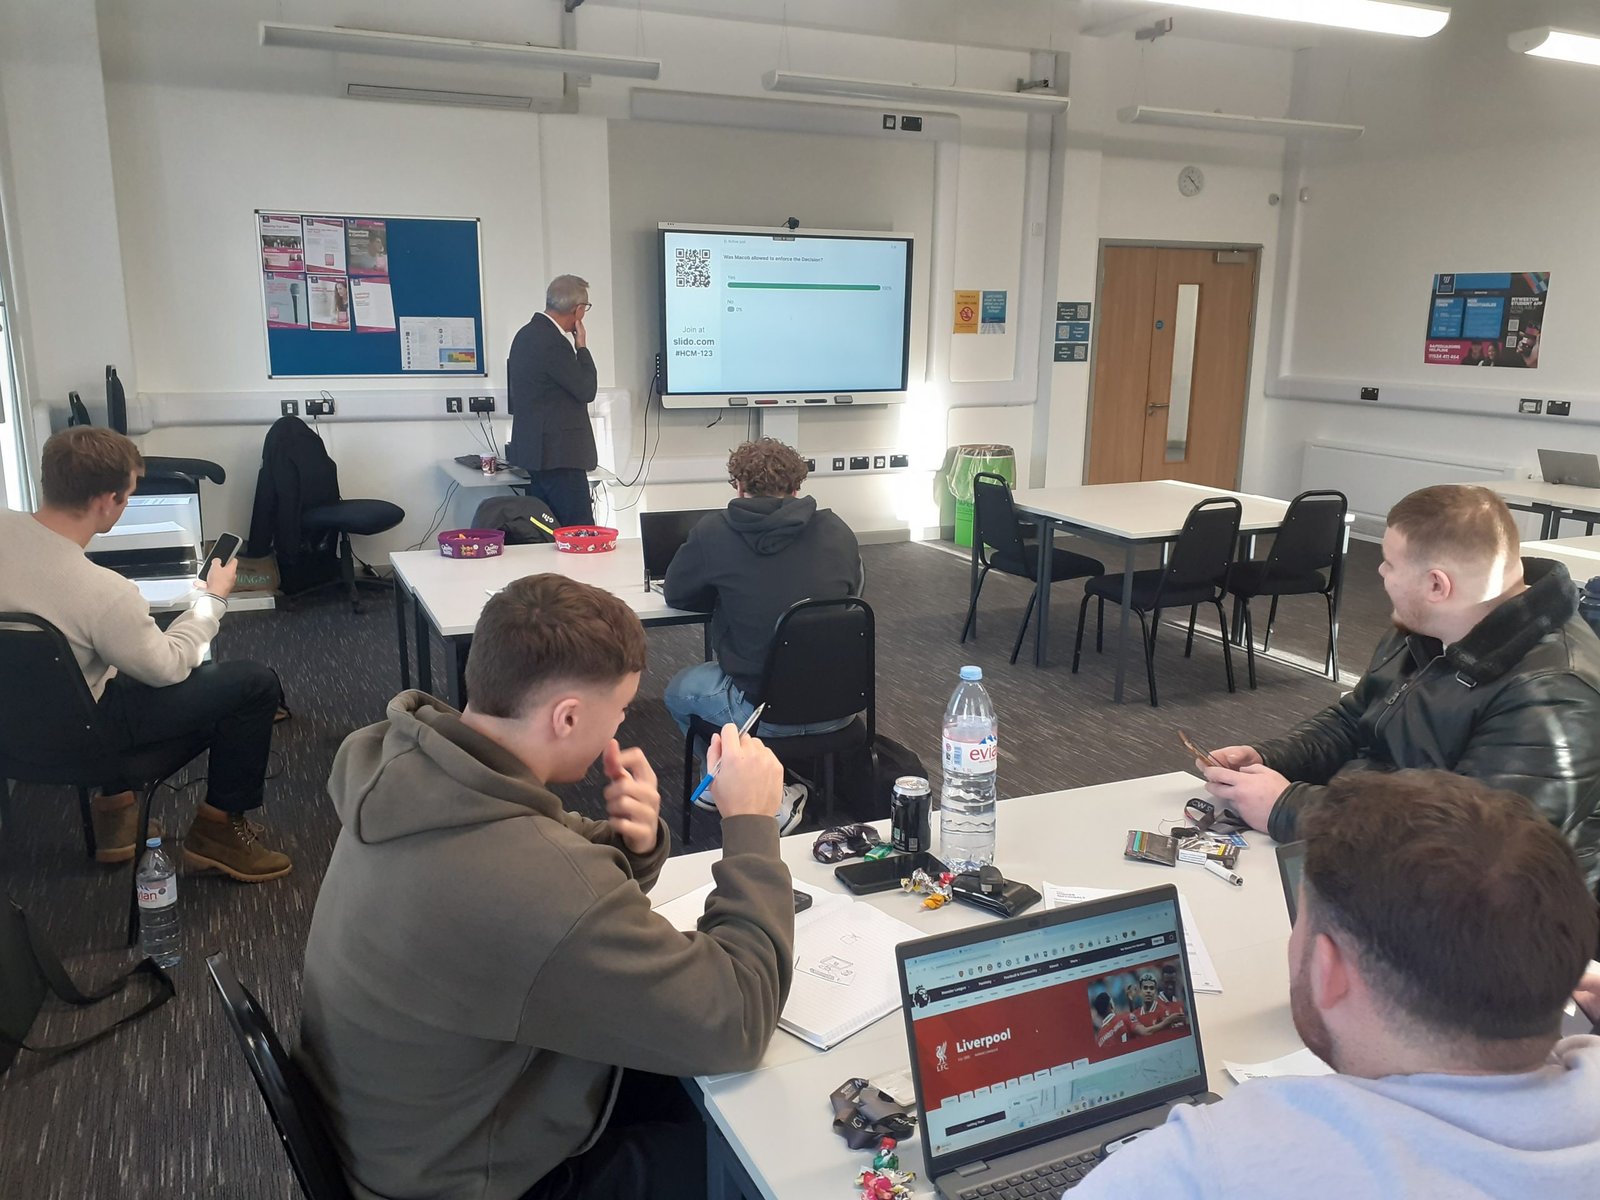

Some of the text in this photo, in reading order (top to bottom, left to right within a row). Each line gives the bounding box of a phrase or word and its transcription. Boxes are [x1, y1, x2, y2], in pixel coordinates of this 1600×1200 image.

[673, 337, 715, 346] slido.com
[956, 1028, 1012, 1053] Liverpool
[936, 1063, 949, 1072] LFC
